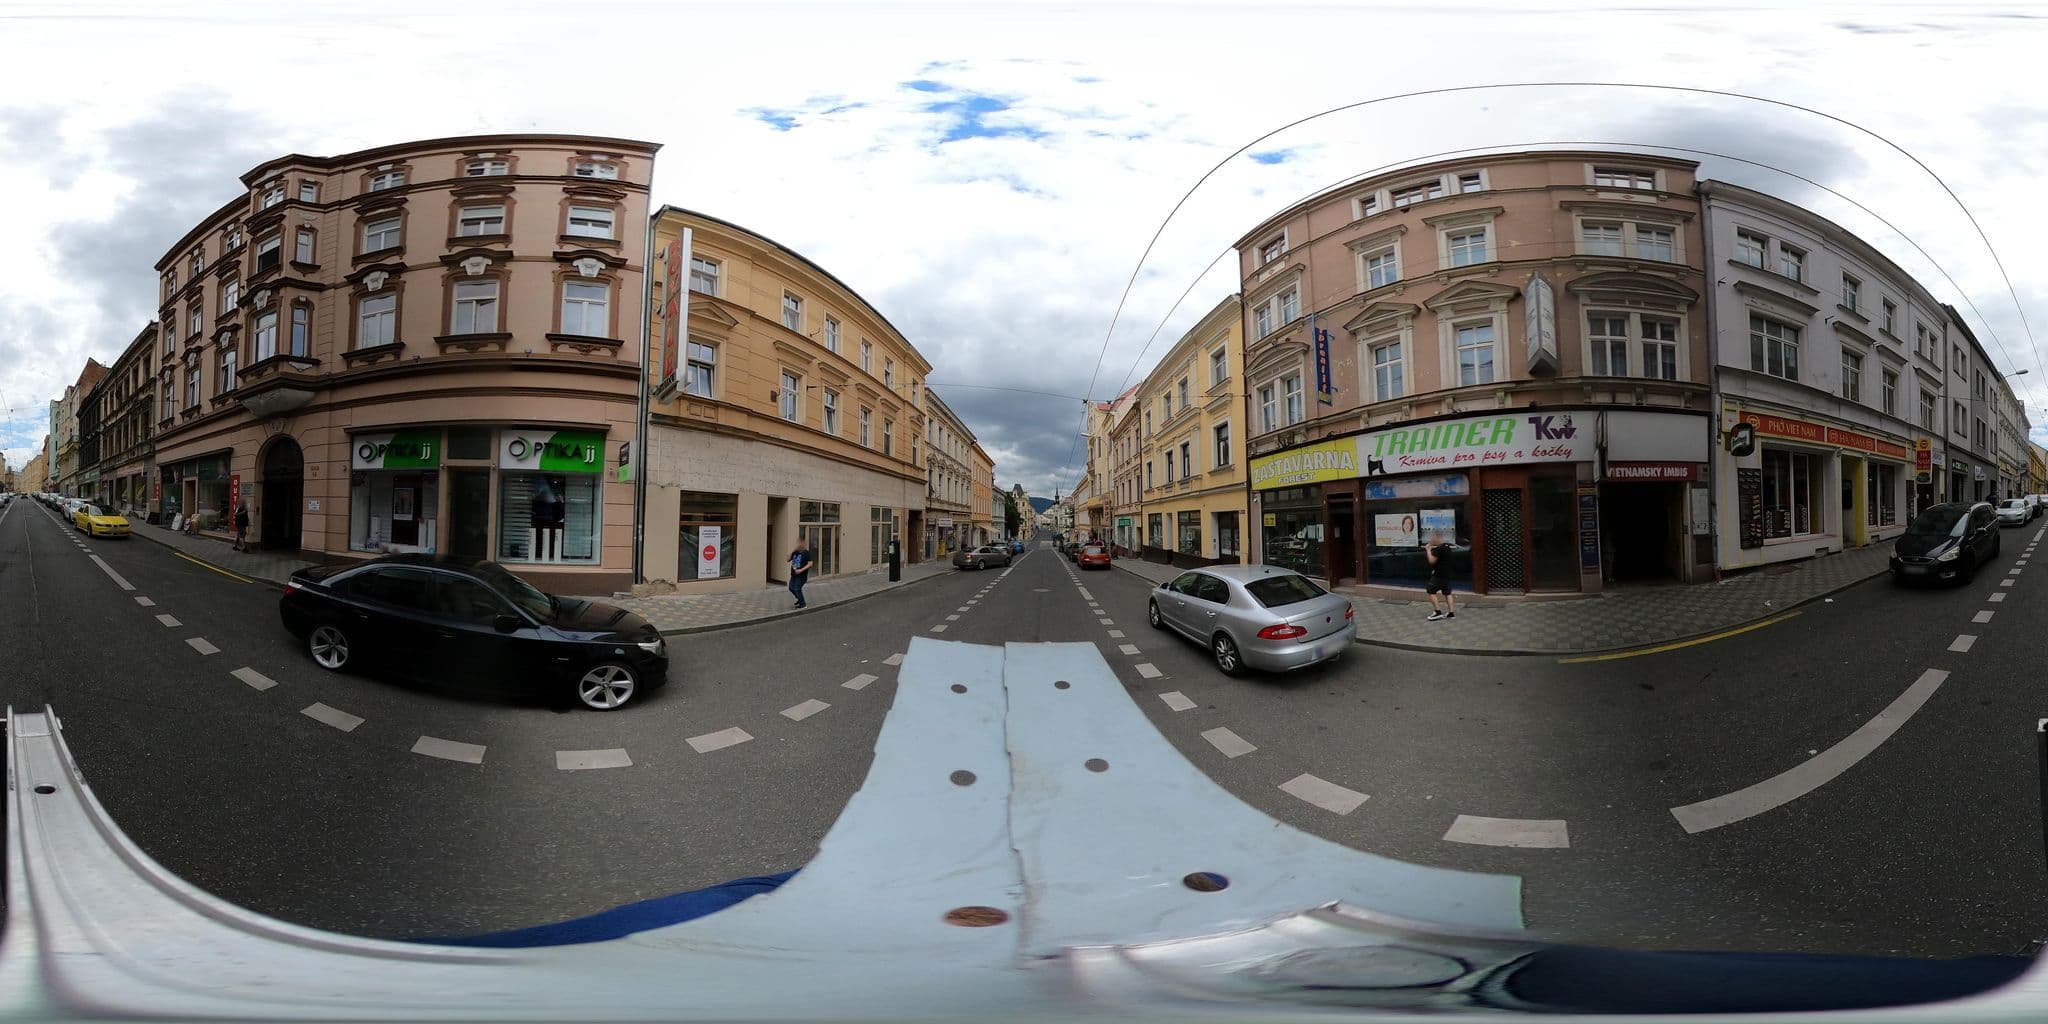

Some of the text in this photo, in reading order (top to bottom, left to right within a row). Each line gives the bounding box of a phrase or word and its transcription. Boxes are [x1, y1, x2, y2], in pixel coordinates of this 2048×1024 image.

[508, 436, 583, 461] OPTIKA
[1374, 418, 1517, 458] TRAINER
[1398, 443, 1574, 468] Krmiva pro psy a kočky
[1278, 472, 1315, 484] FOREST
